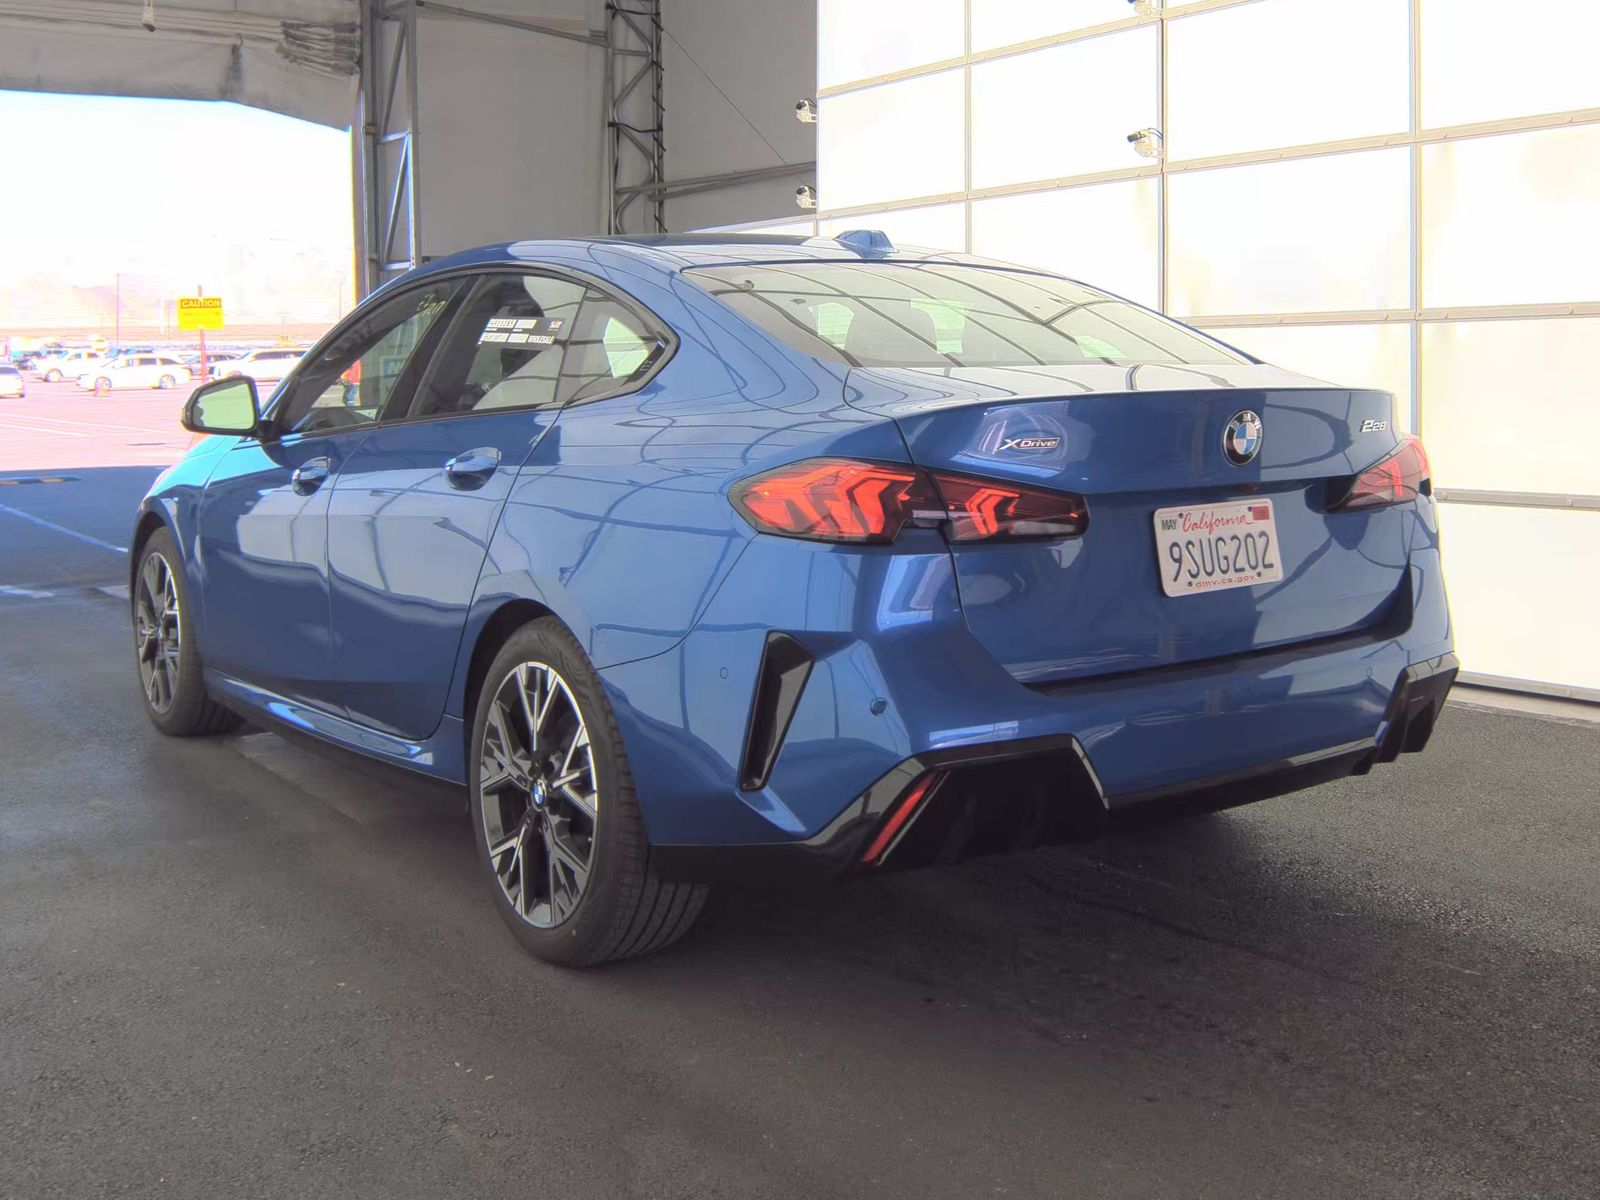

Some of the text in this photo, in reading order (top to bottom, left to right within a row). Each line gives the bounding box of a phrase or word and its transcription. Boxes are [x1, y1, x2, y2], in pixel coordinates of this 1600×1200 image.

[182, 299, 220, 307] CAUTION
[1361, 419, 1387, 433] 228
[1161, 518, 1178, 531] MAY
[1182, 510, 1255, 534] California
[1169, 530, 1274, 583] 9SUG202
[1195, 574, 1256, 588] dmv.ca.gov
